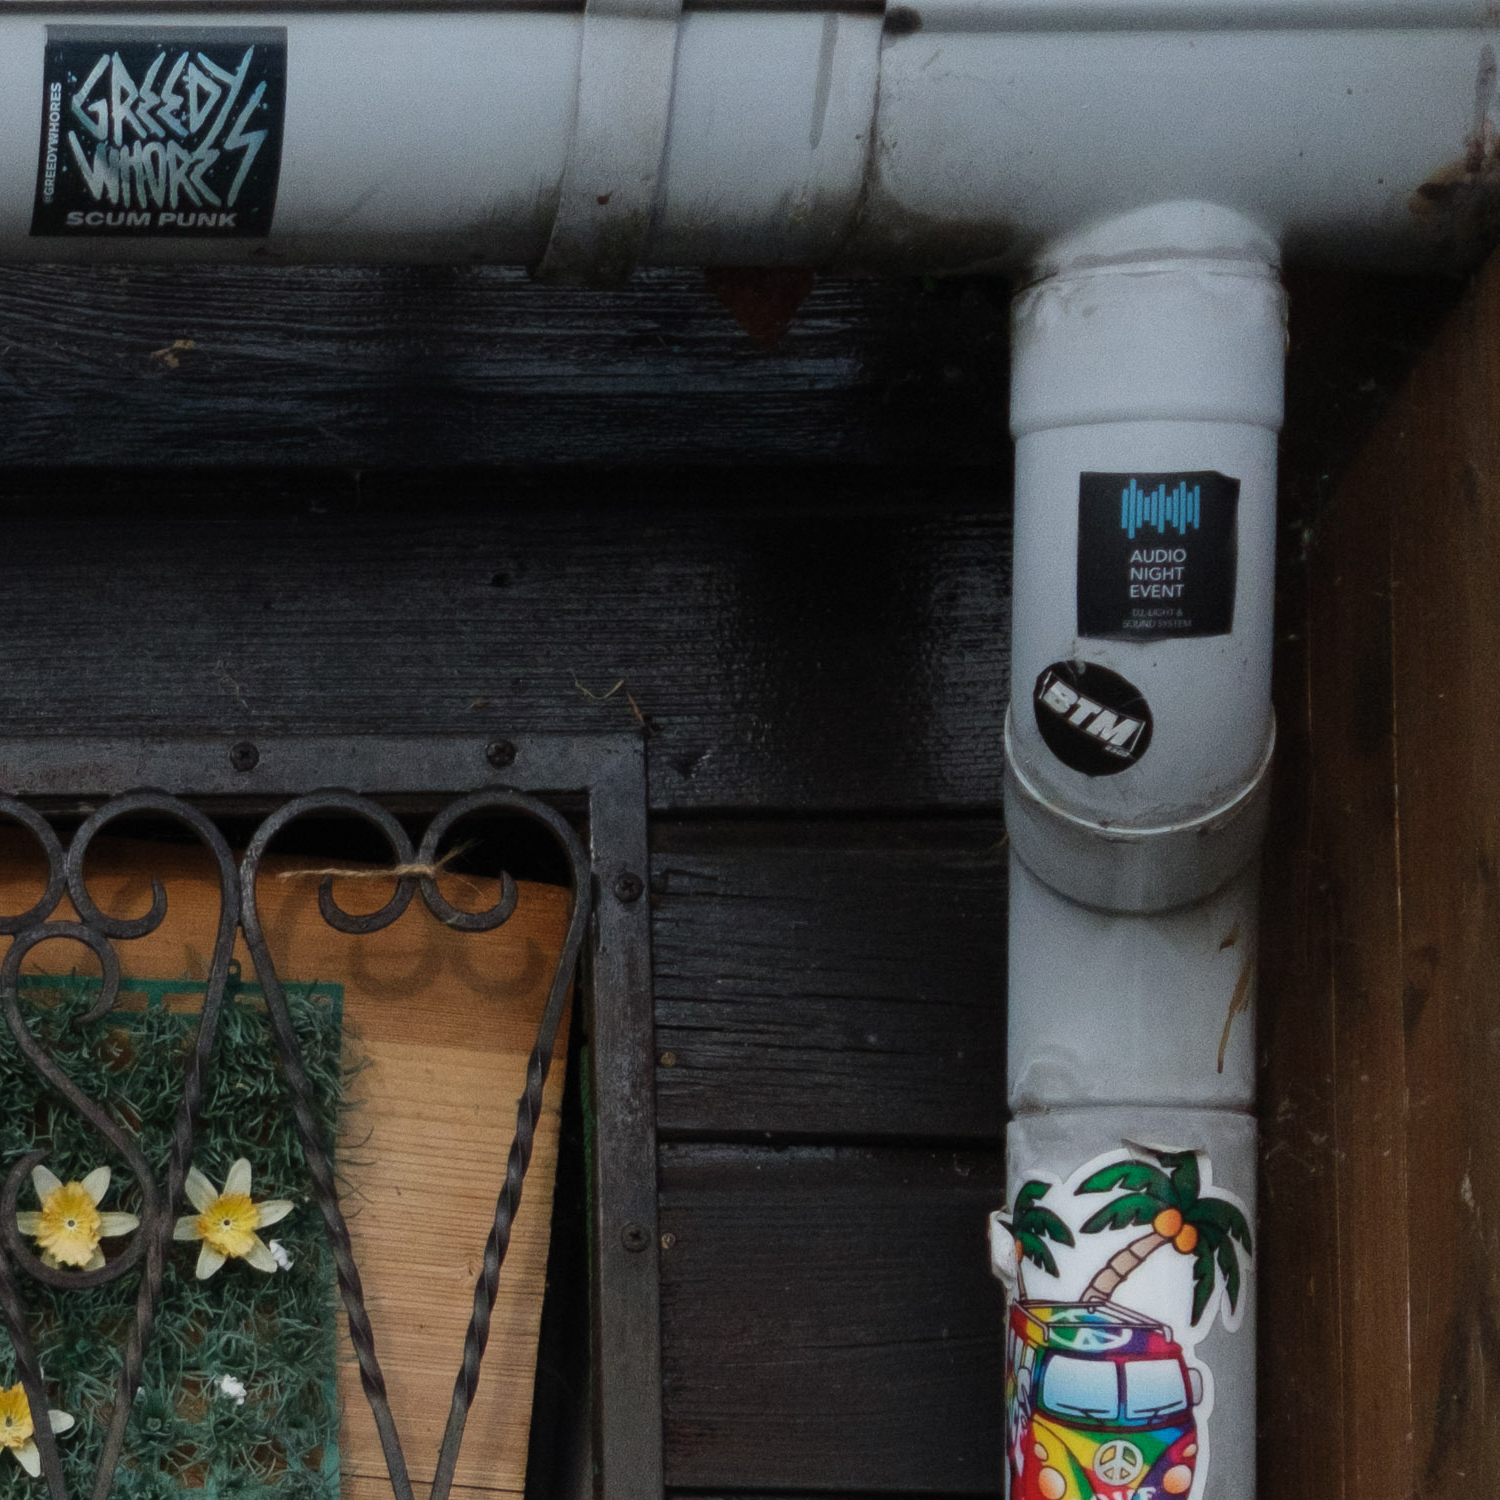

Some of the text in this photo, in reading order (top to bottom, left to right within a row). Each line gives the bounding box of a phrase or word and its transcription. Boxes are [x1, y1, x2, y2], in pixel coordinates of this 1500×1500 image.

[65, 211, 238, 228] SCUM PUNK
[1130, 549, 1187, 564] AUDIO
[1130, 566, 1186, 581] NIGHT
[1129, 584, 1185, 598] EVENT
[1041, 680, 1145, 747] BTM
